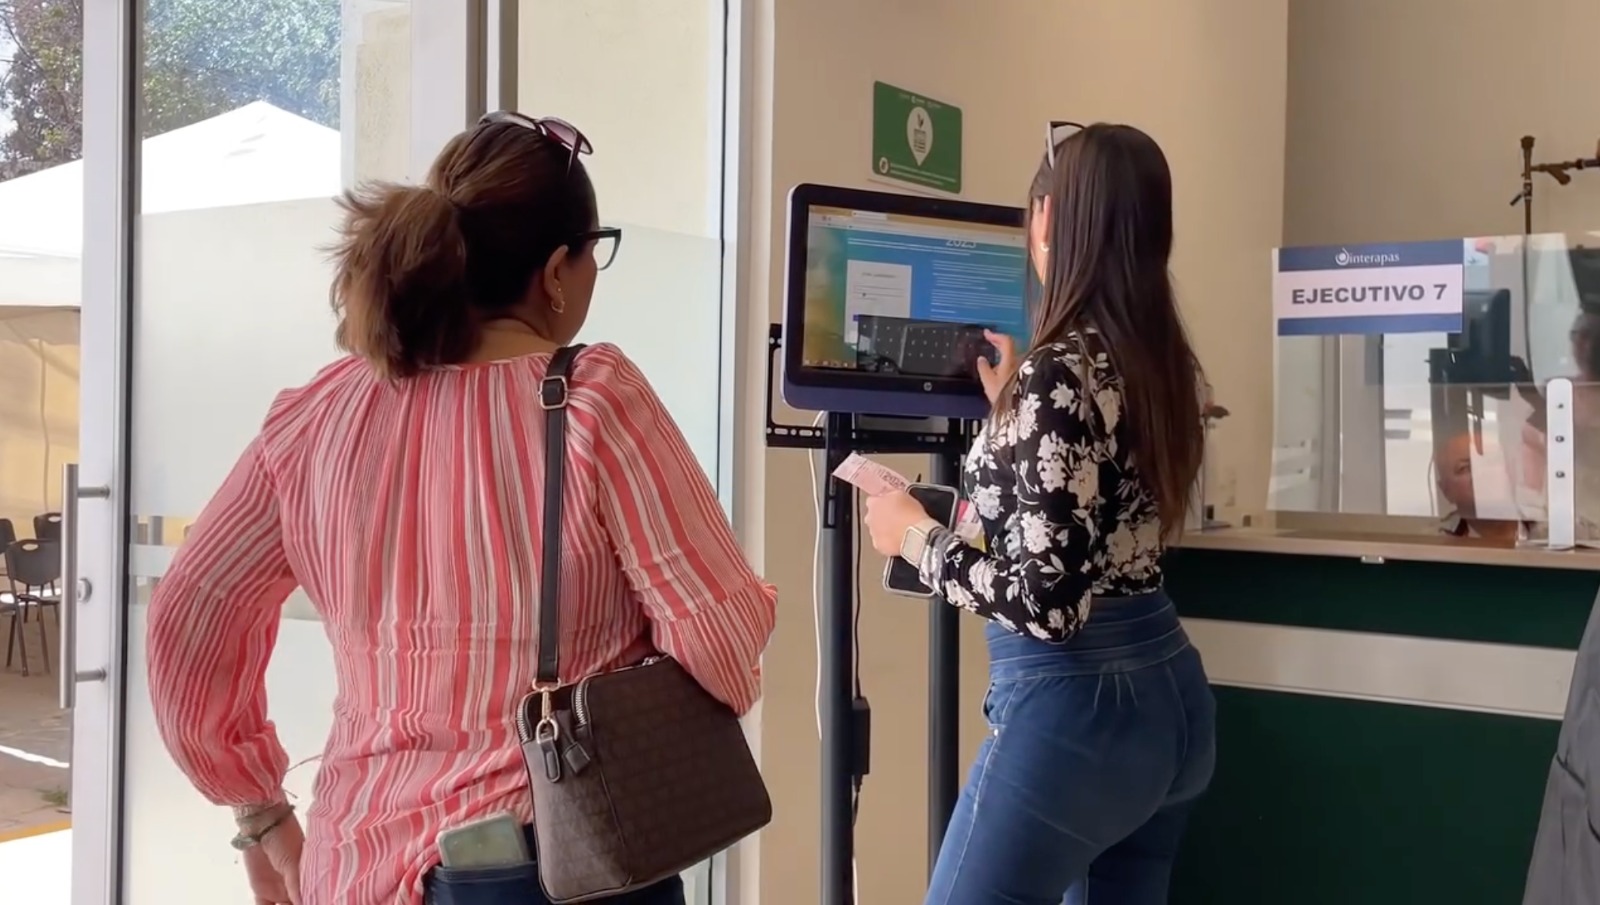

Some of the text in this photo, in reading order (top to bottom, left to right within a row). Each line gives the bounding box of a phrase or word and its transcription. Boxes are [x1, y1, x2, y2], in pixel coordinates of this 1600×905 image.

[1349, 253, 1400, 266] interapas
[1292, 284, 1447, 304] EJECUTIVO 7
